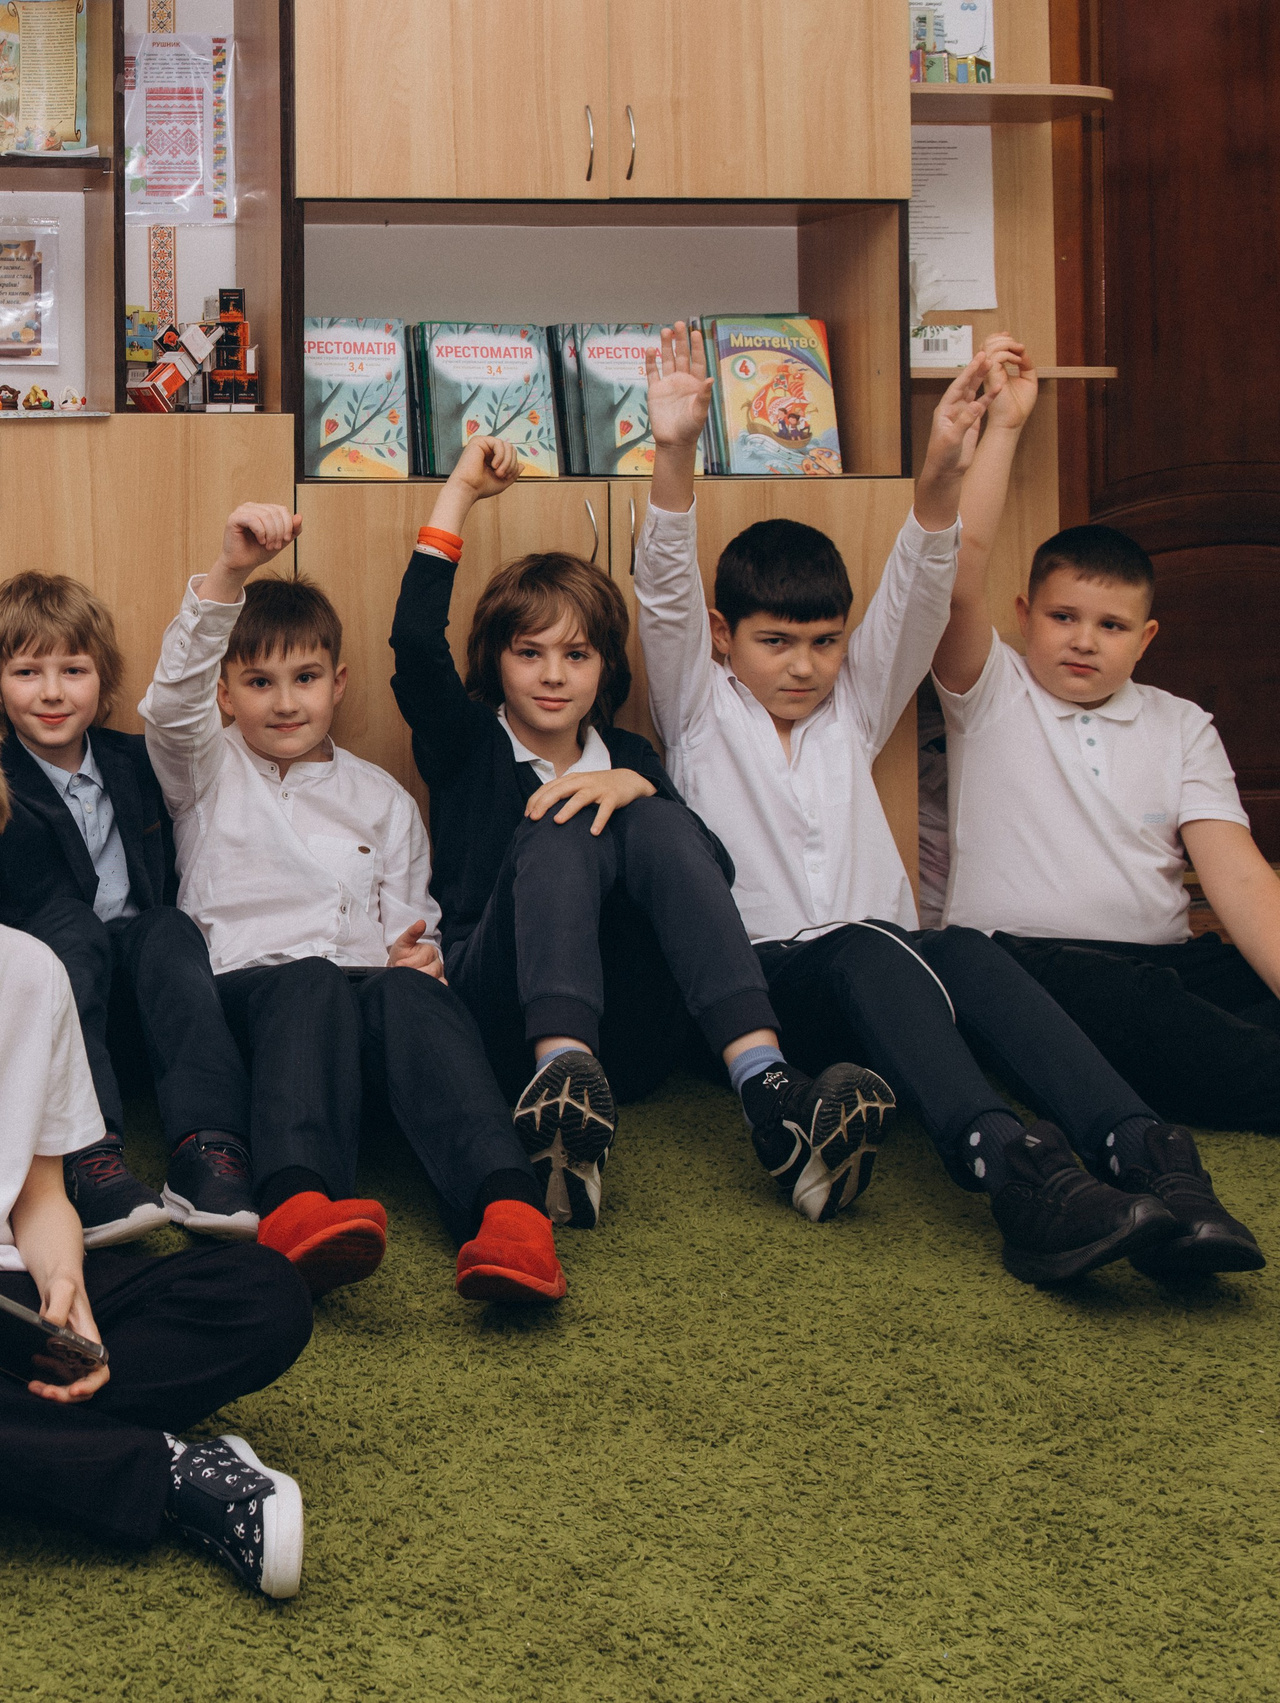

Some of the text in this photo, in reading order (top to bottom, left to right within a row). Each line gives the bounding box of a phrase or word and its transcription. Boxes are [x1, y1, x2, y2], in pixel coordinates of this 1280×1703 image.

[729, 332, 819, 351] Мистецтво
[435, 345, 533, 359] ХРЕСТОМАТІЯ
[587, 346, 663, 360] ХРЕСТОА
[348, 361, 365, 373] 3,4
[486, 365, 502, 377] 3,4
[739, 359, 750, 376] 4
